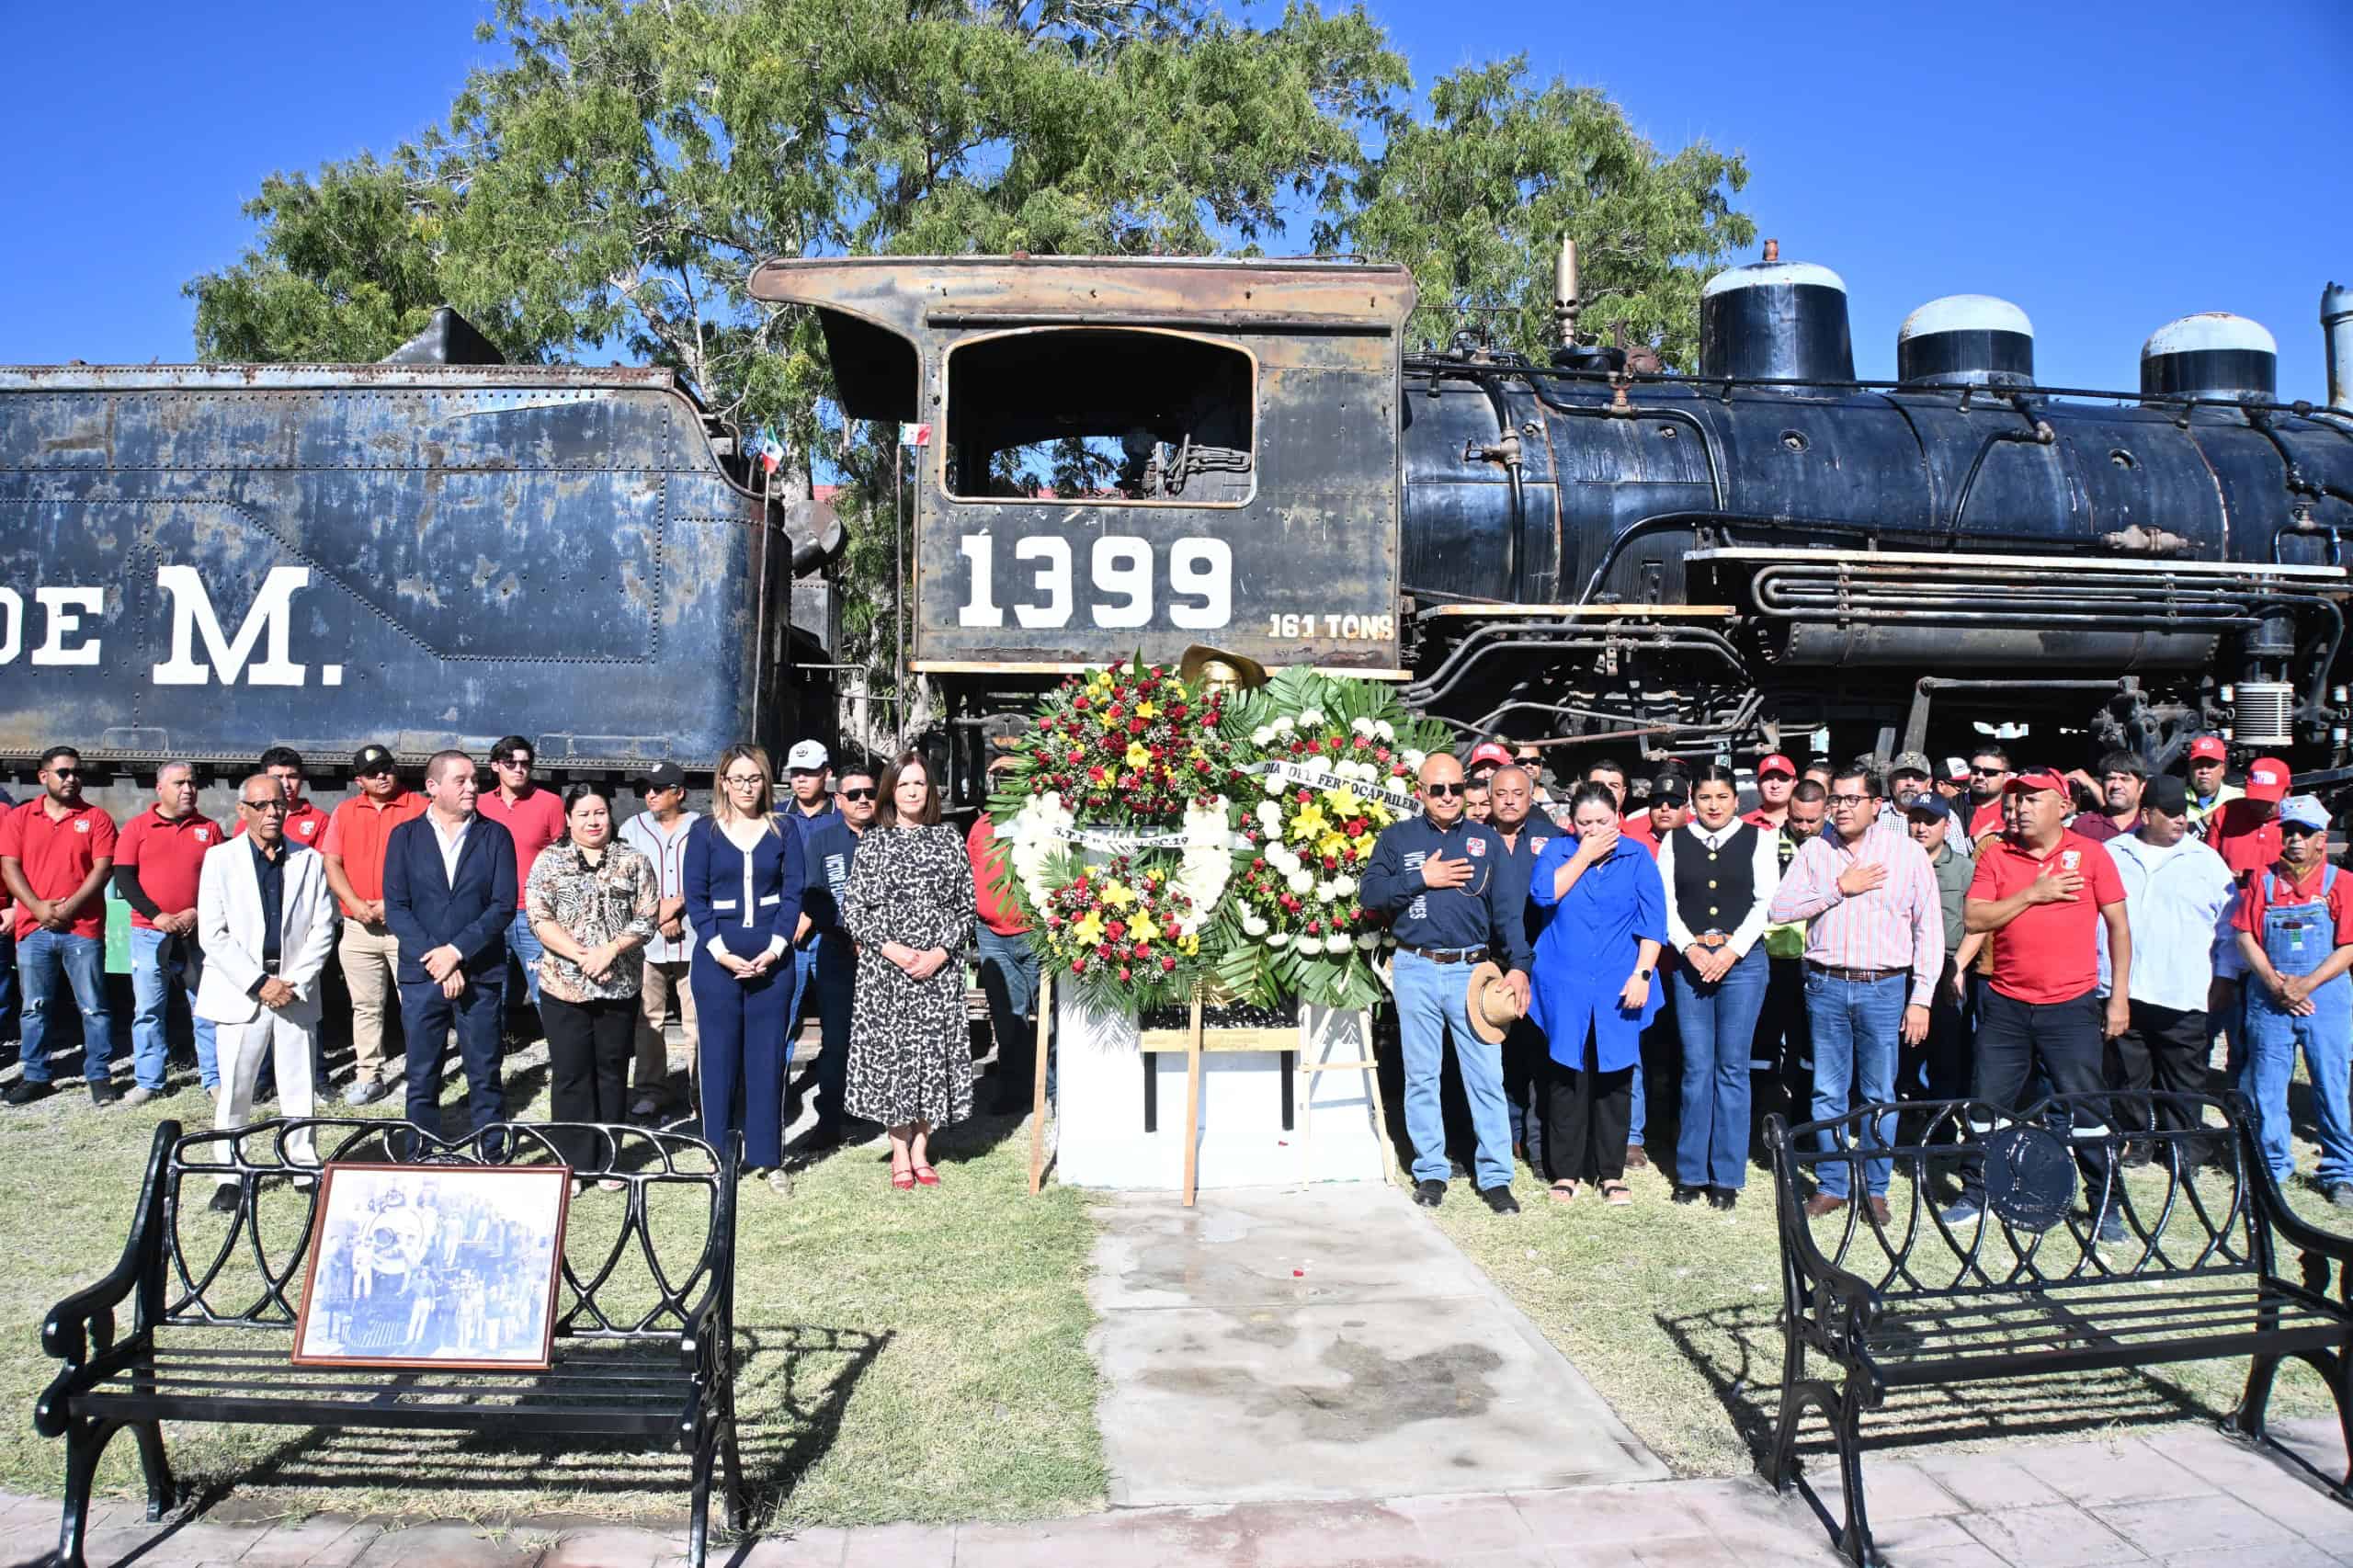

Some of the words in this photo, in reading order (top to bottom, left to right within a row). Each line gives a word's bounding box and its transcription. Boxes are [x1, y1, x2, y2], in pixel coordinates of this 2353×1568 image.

[958, 535, 1233, 630] 1399
[153, 564, 343, 687] M.
[1268, 613, 1315, 638] 161
[1324, 614, 1395, 641] TONS
[1263, 763, 1280, 774] DIA
[824, 853, 847, 883] VICTOR
[1404, 850, 1427, 874] VICT
[1408, 894, 1427, 920] ORES
